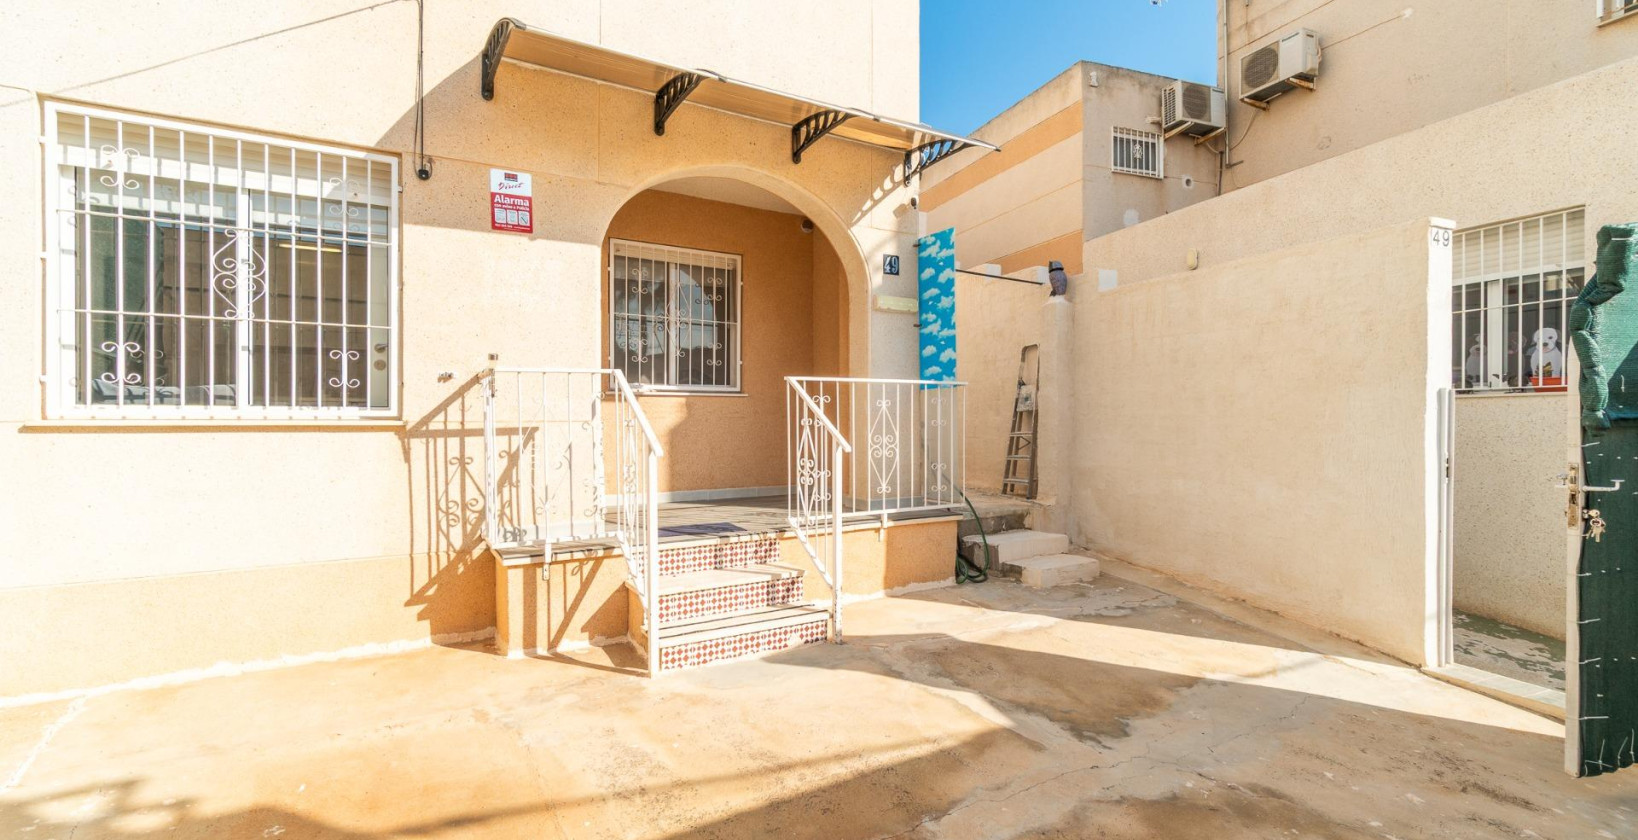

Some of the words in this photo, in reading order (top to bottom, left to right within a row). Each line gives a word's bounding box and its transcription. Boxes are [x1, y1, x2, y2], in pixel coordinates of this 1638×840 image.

[494, 195, 529, 207] Alarma
[1433, 230, 1450, 247] 49
[884, 256, 898, 274] 49
